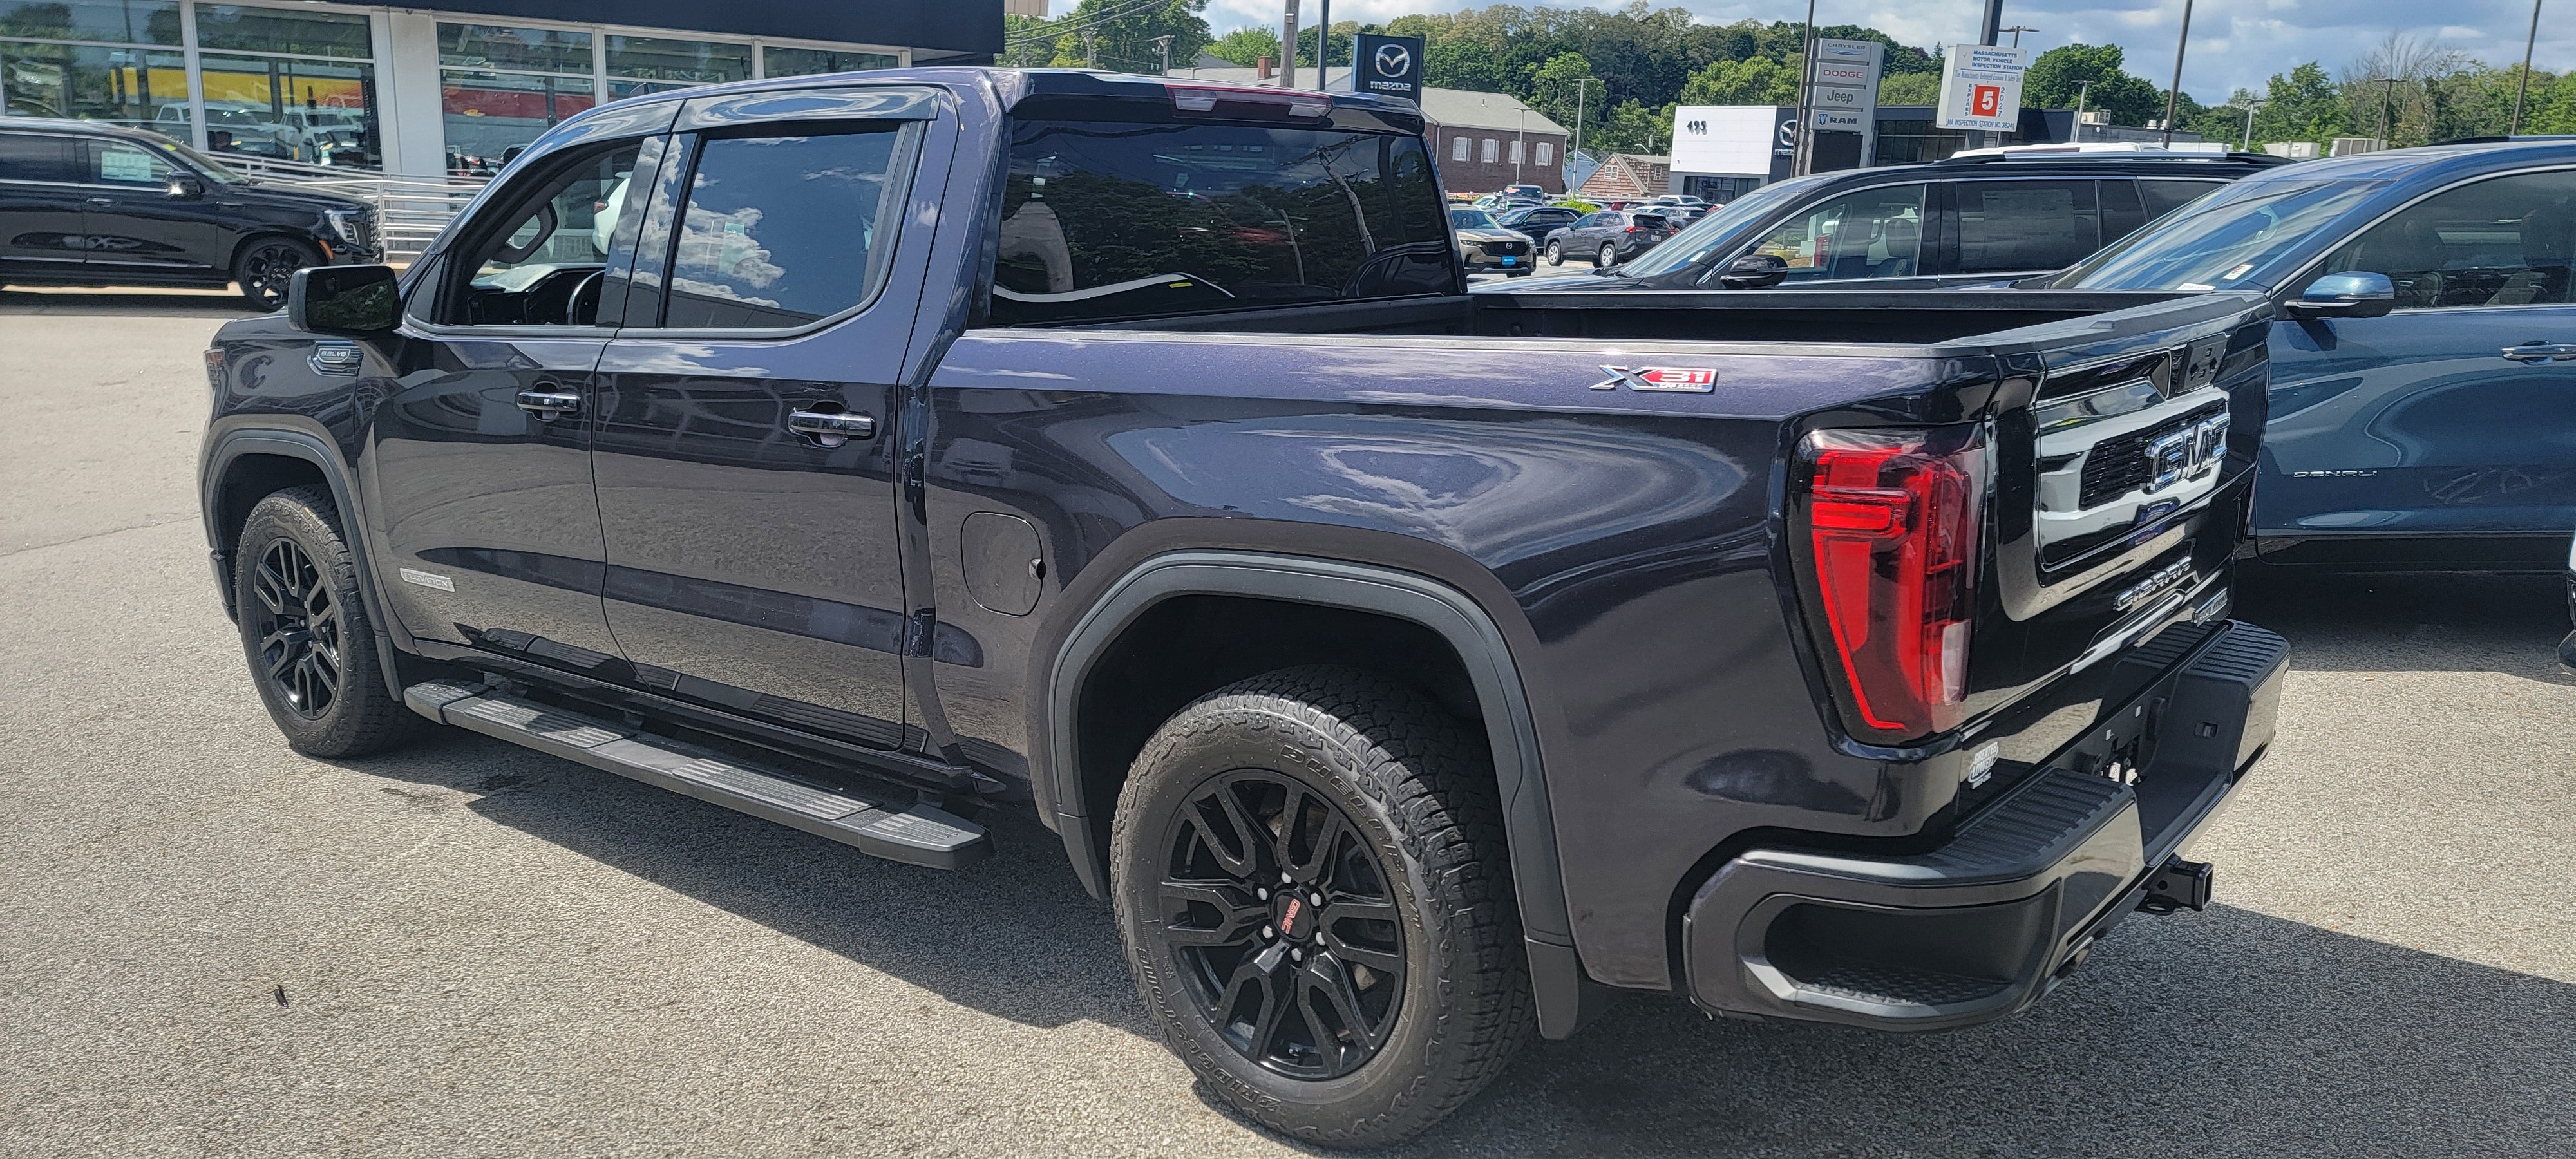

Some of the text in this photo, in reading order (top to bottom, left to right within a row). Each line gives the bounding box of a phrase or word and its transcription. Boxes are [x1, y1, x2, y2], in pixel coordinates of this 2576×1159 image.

[1823, 70, 1864, 78] DODGE
[1827, 90, 1853, 104] Jeep
[1982, 91, 1994, 111] 5
[1687, 120, 1707, 131] 495
[2149, 413, 2230, 492] GMC
[403, 572, 449, 588] ELEVATION
[2114, 556, 2192, 611] SIERRA
[1974, 742, 1998, 764] GREATER
[1281, 899, 1300, 934] GMC
